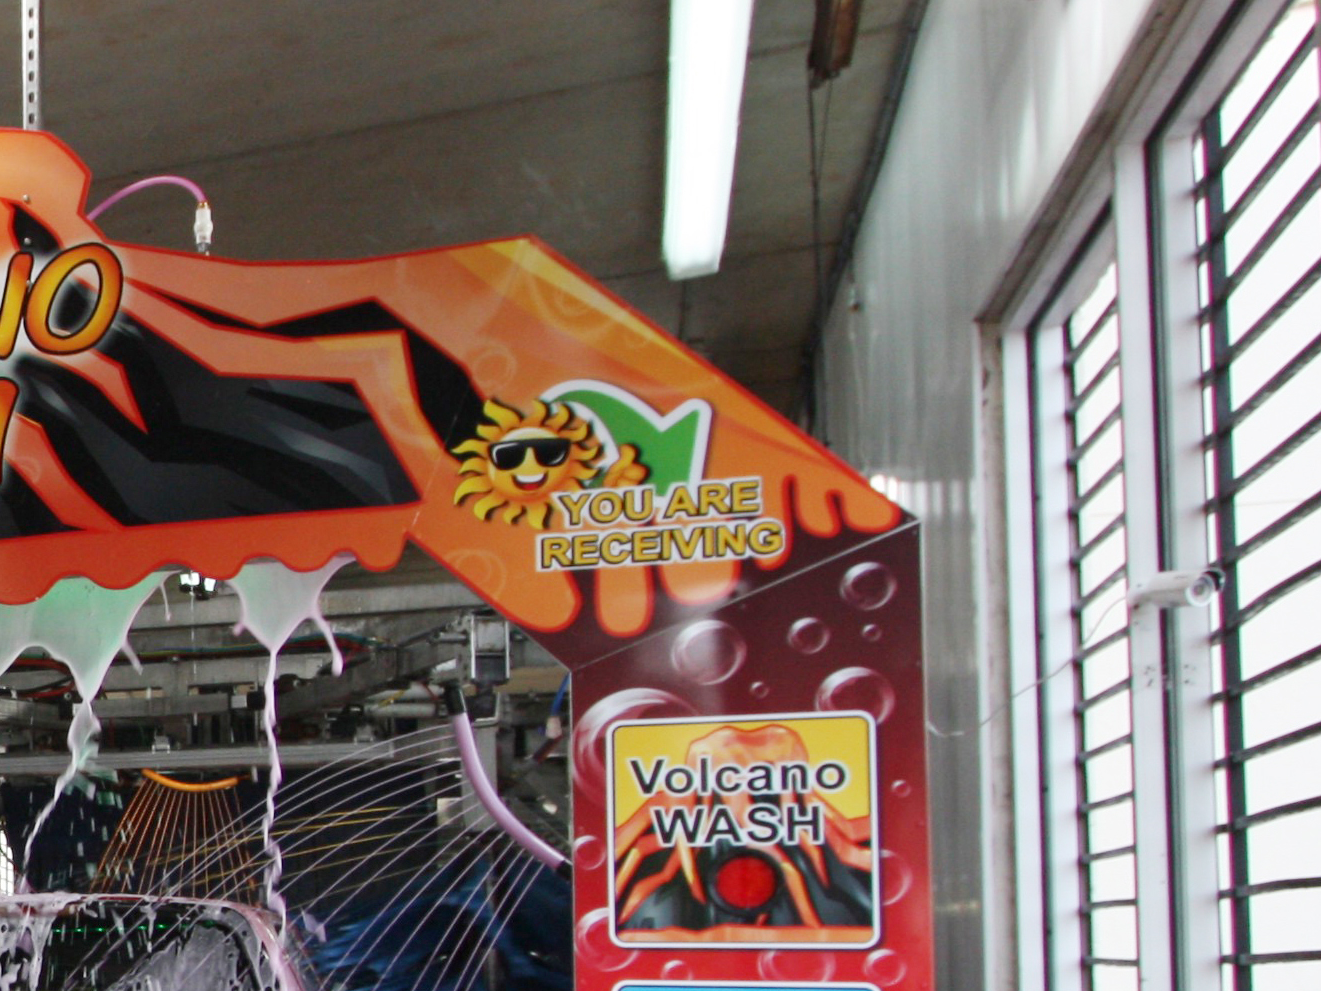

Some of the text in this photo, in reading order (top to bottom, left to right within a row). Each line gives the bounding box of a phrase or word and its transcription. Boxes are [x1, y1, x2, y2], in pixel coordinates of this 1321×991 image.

[558, 481, 760, 526] YOU ARE
[540, 521, 784, 569] RECEIVING
[630, 757, 847, 795] Volcano
[654, 805, 822, 845] WASH
